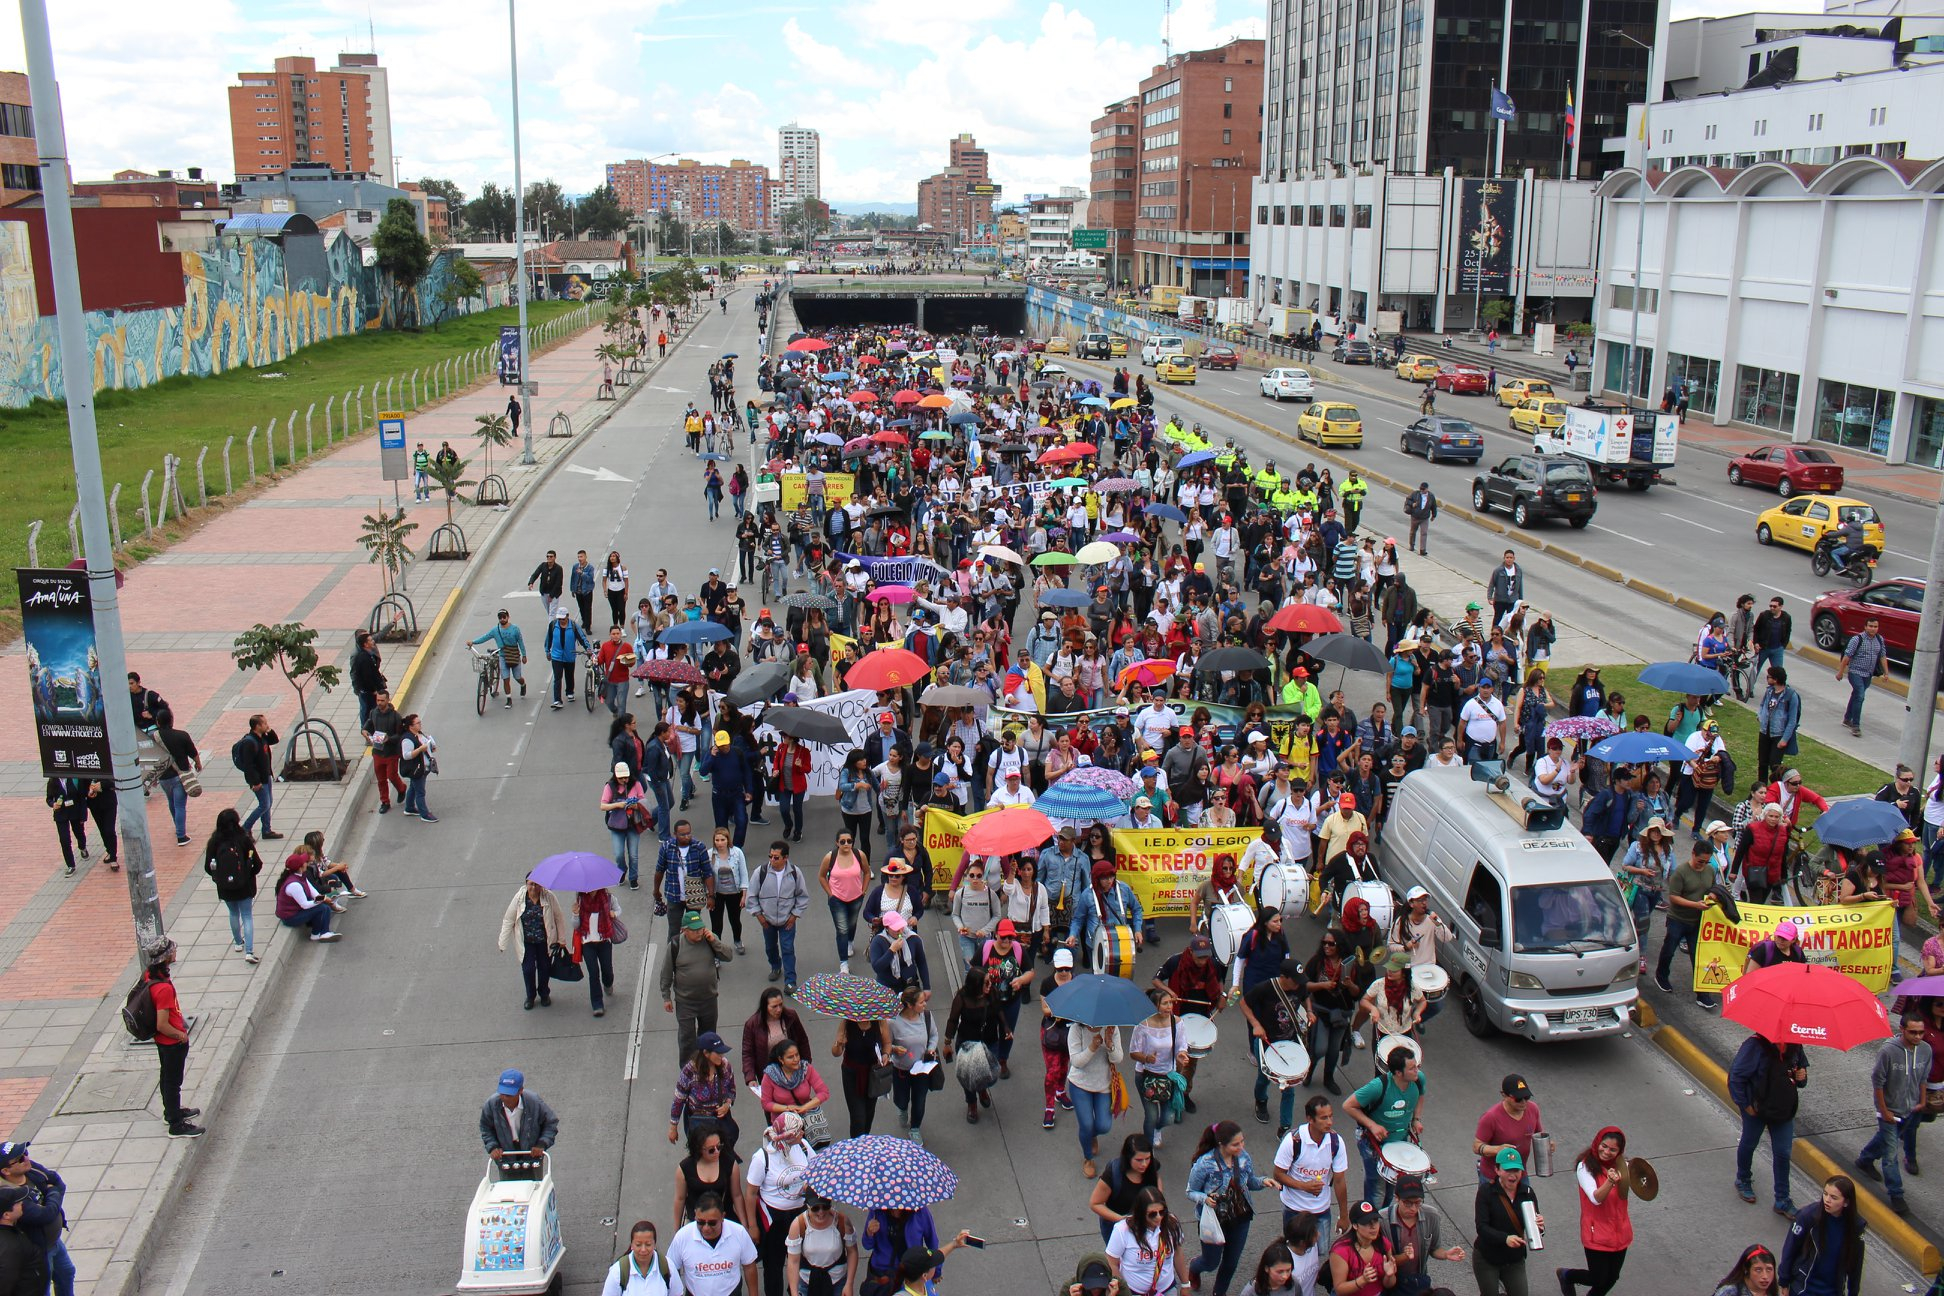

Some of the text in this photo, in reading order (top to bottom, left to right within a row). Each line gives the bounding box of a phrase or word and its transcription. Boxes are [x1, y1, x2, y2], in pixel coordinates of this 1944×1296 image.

[871, 561, 913, 583] COLEGIO
[1144, 835, 1251, 847] I.E.D. COLEGIO
[1115, 852, 1207, 872] RESTREPO
[1150, 875, 1180, 885] Localidad
[1181, 874, 1189, 883] 18
[1790, 1023, 1827, 1036] Eternit
[1791, 1222, 1803, 1236] 18
